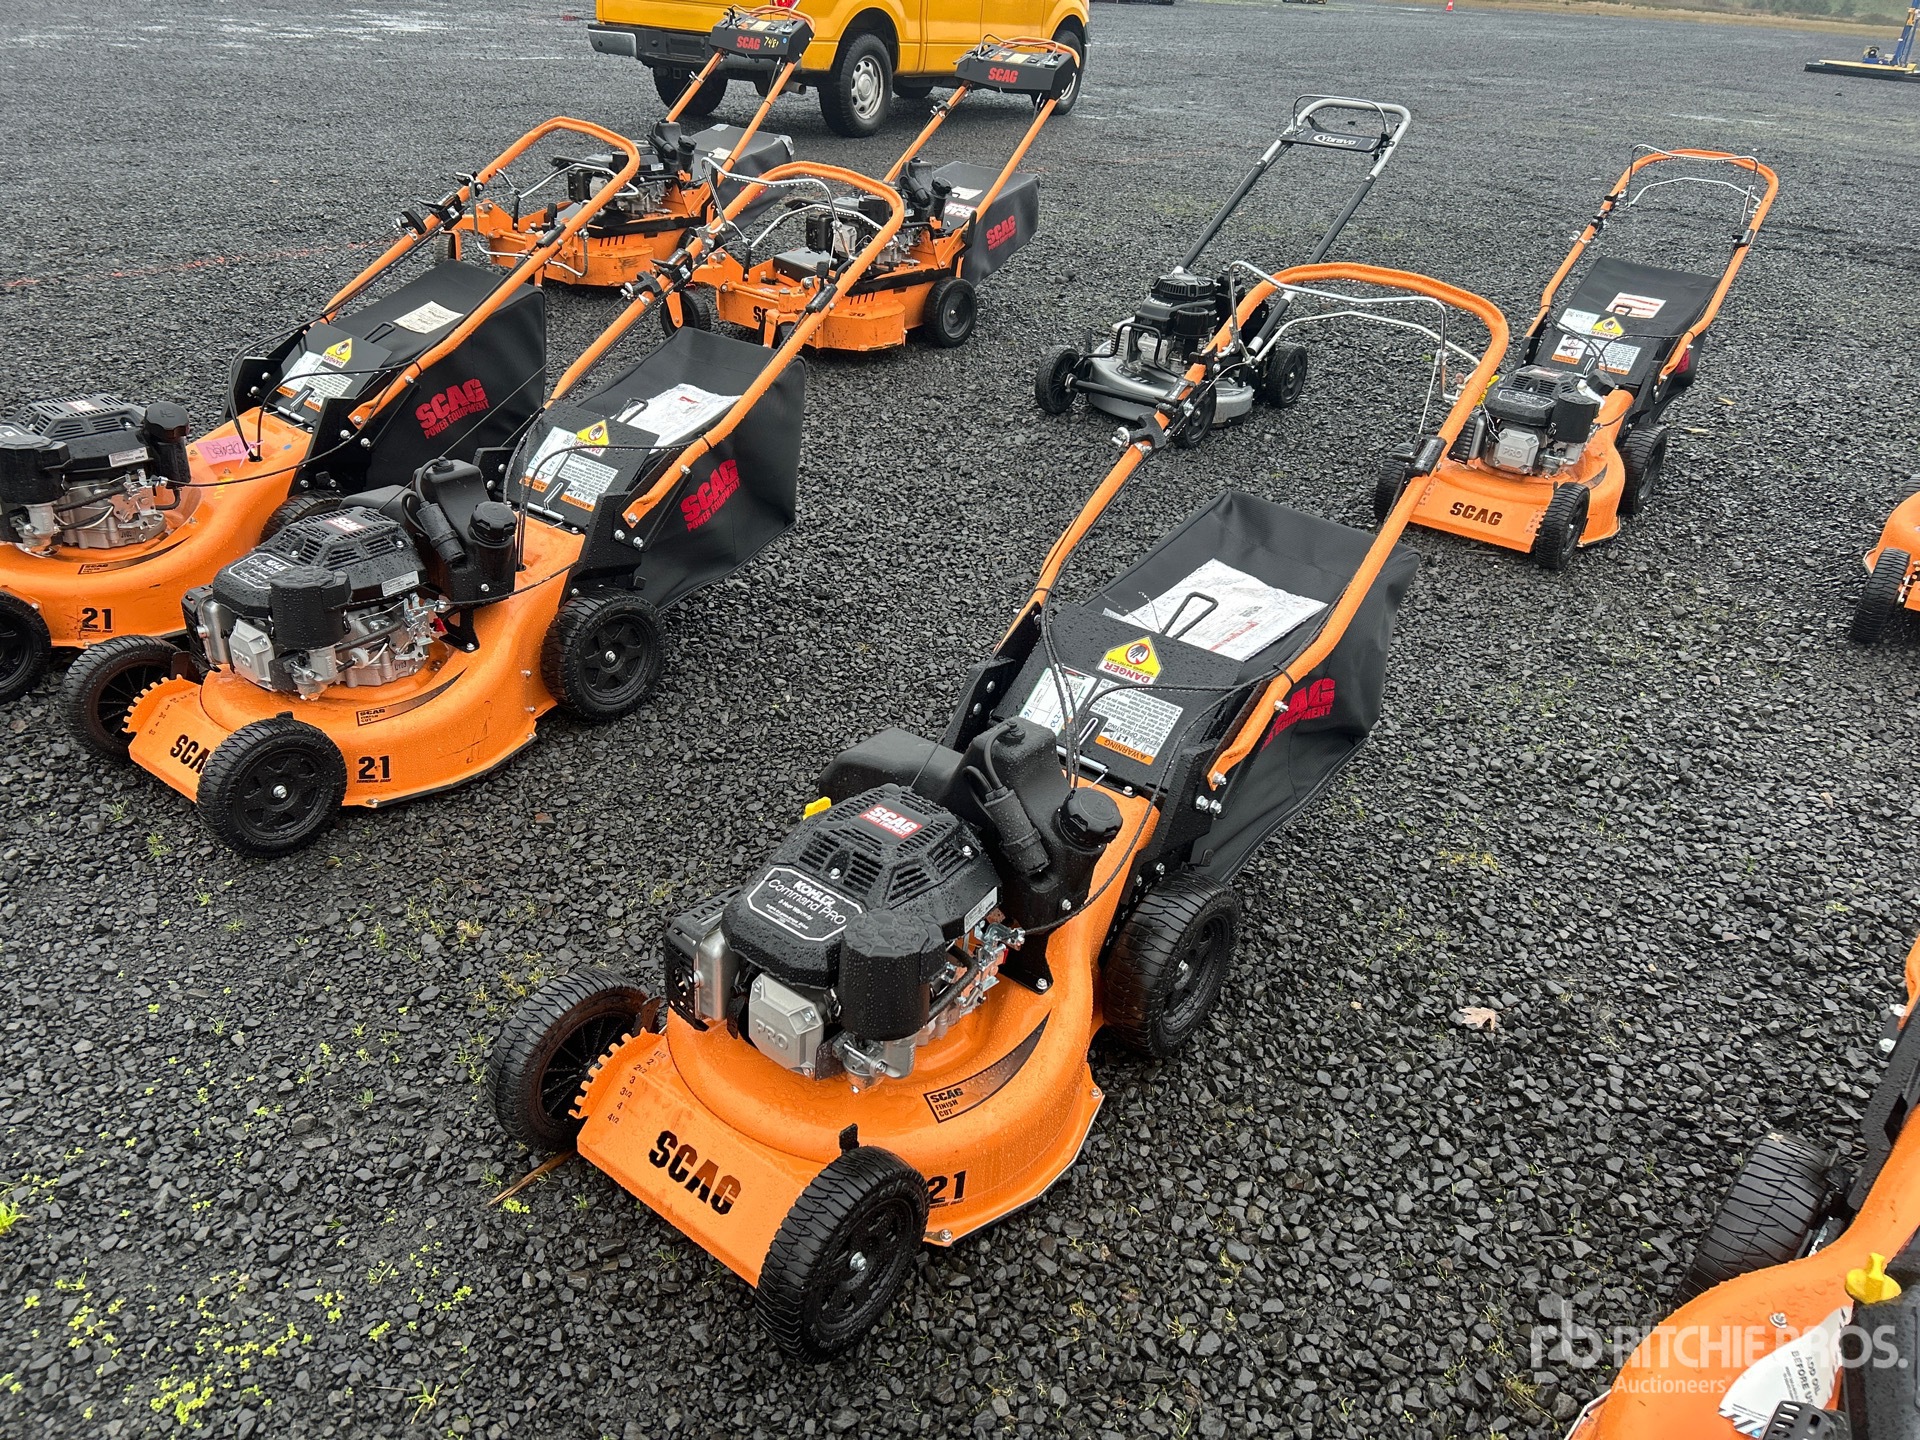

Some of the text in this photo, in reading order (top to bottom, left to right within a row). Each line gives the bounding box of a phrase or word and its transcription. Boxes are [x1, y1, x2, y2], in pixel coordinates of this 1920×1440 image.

[736, 36, 760, 50] SCAG
[988, 67, 1018, 84] SCAG
[986, 215, 1016, 245] SCAG
[415, 378, 486, 429] SCAG
[424, 398, 490, 439] POWER EQUIPMENT
[1502, 446, 1523, 458] PRO
[680, 459, 739, 522] SCAG
[687, 478, 740, 532] POWER EQUIPMENT
[1450, 502, 1503, 526] SCAG
[82, 608, 112, 630] 21
[1104, 662, 1150, 684] DANGER
[360, 708, 386, 716] SCAG
[1105, 721, 1161, 747] BEFORE OPERATING
[170, 734, 210, 774] SCA
[1104, 739, 1140, 760] WARNING
[358, 755, 390, 780] 21
[870, 806, 918, 833] SCAG
[768, 879, 822, 912] Command
[818, 906, 846, 925] PRO
[792, 880, 836, 908] KOHLER
[756, 1018, 789, 1050] PRO
[630, 1076, 636, 1084] 3
[616, 1102, 624, 1110] 4
[930, 1088, 964, 1104] SCAG
[935, 1100, 958, 1110] FINISH
[938, 1108, 952, 1118] CUT
[648, 1130, 742, 1215] SCAG
[928, 1170, 966, 1205] 21
[1791, 1350, 1810, 1390] BEFORE
